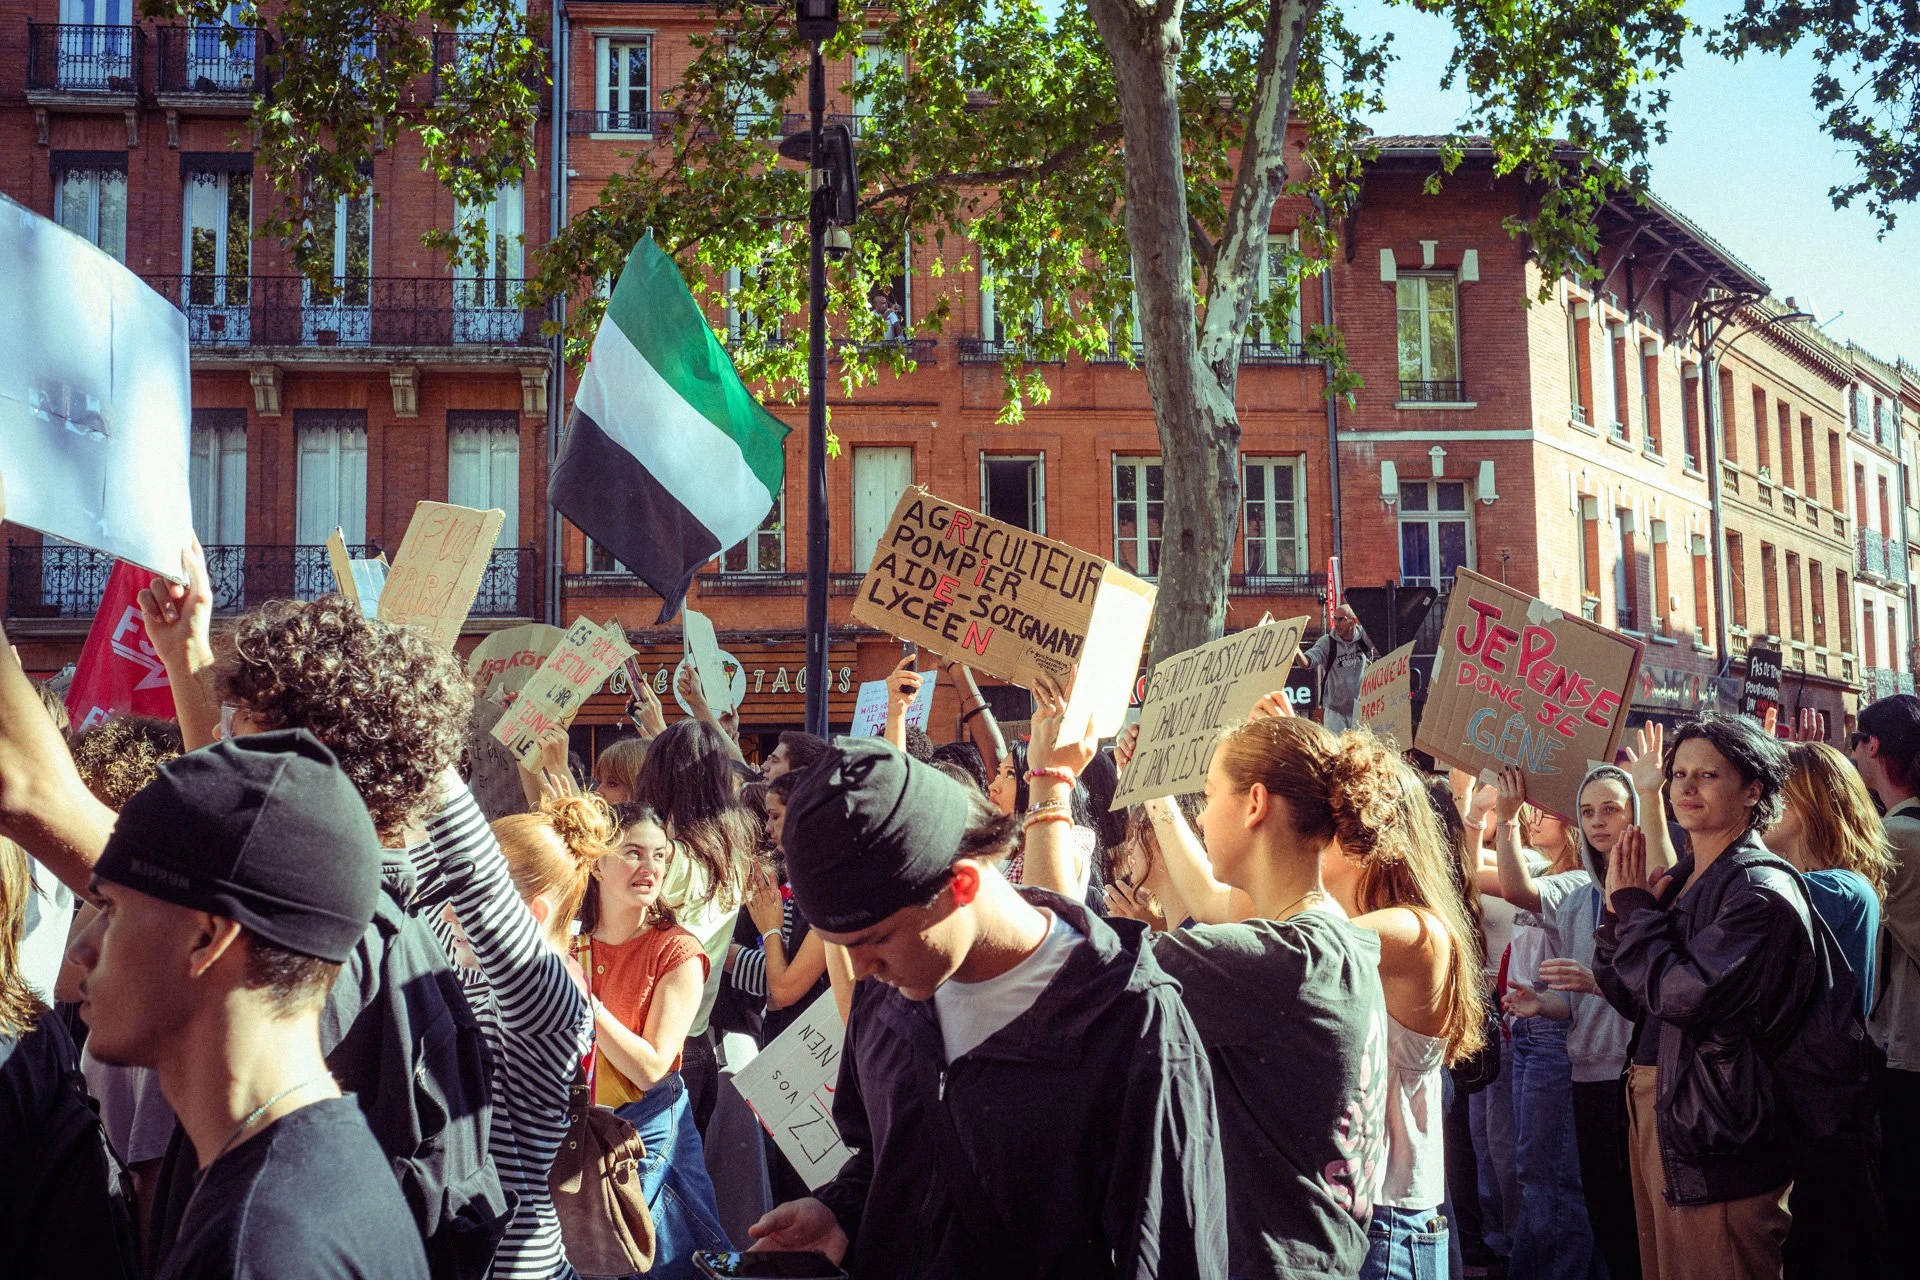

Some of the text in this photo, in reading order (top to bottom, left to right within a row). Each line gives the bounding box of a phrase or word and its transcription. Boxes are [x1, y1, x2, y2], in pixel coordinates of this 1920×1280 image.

[902, 500, 1103, 607] AGRICULTEUR
[868, 577, 994, 656] LYCÉEN
[875, 552, 1085, 659] AIDE-SOIGNANT
[1234, 626, 1298, 678] CHAUD
[1456, 596, 1623, 729] JE PENSE
[1197, 680, 1238, 733] RUE
[1362, 695, 1385, 720] PROFS
[1456, 661, 1526, 713] DONC
[1535, 701, 1583, 738] JE
[1172, 735, 1203, 782] LES
[1466, 706, 1566, 776] GÊNE
